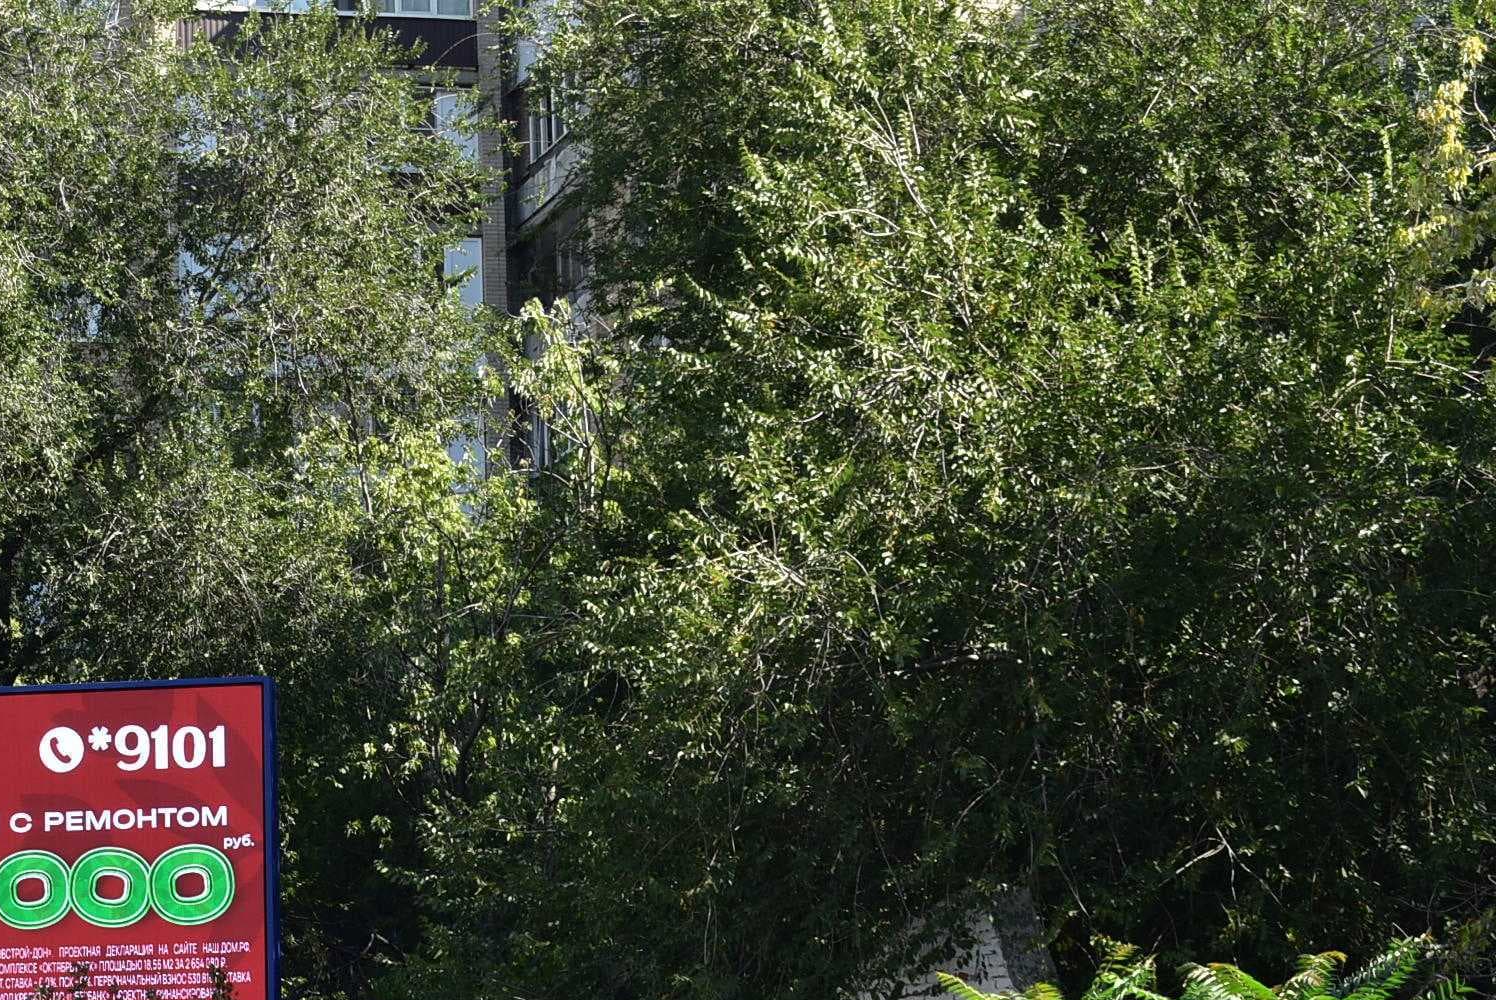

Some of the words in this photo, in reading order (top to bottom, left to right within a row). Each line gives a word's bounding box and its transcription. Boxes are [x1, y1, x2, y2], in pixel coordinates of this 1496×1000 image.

[9, 812, 32, 833] С
[44, 806, 228, 832] РЕМОНТОМ
[223, 834, 255, 849] руб.
[58, 945, 101, 958] ПРОЕКТНАЯ
[105, 943, 154, 958] ДЕКЛАРАЦИЯ
[158, 943, 169, 955] НА
[173, 941, 198, 955] САЙТЕ
[5, 977, 33, 989] СТАВКА
[162, 972, 187, 985] ВЗНОС
